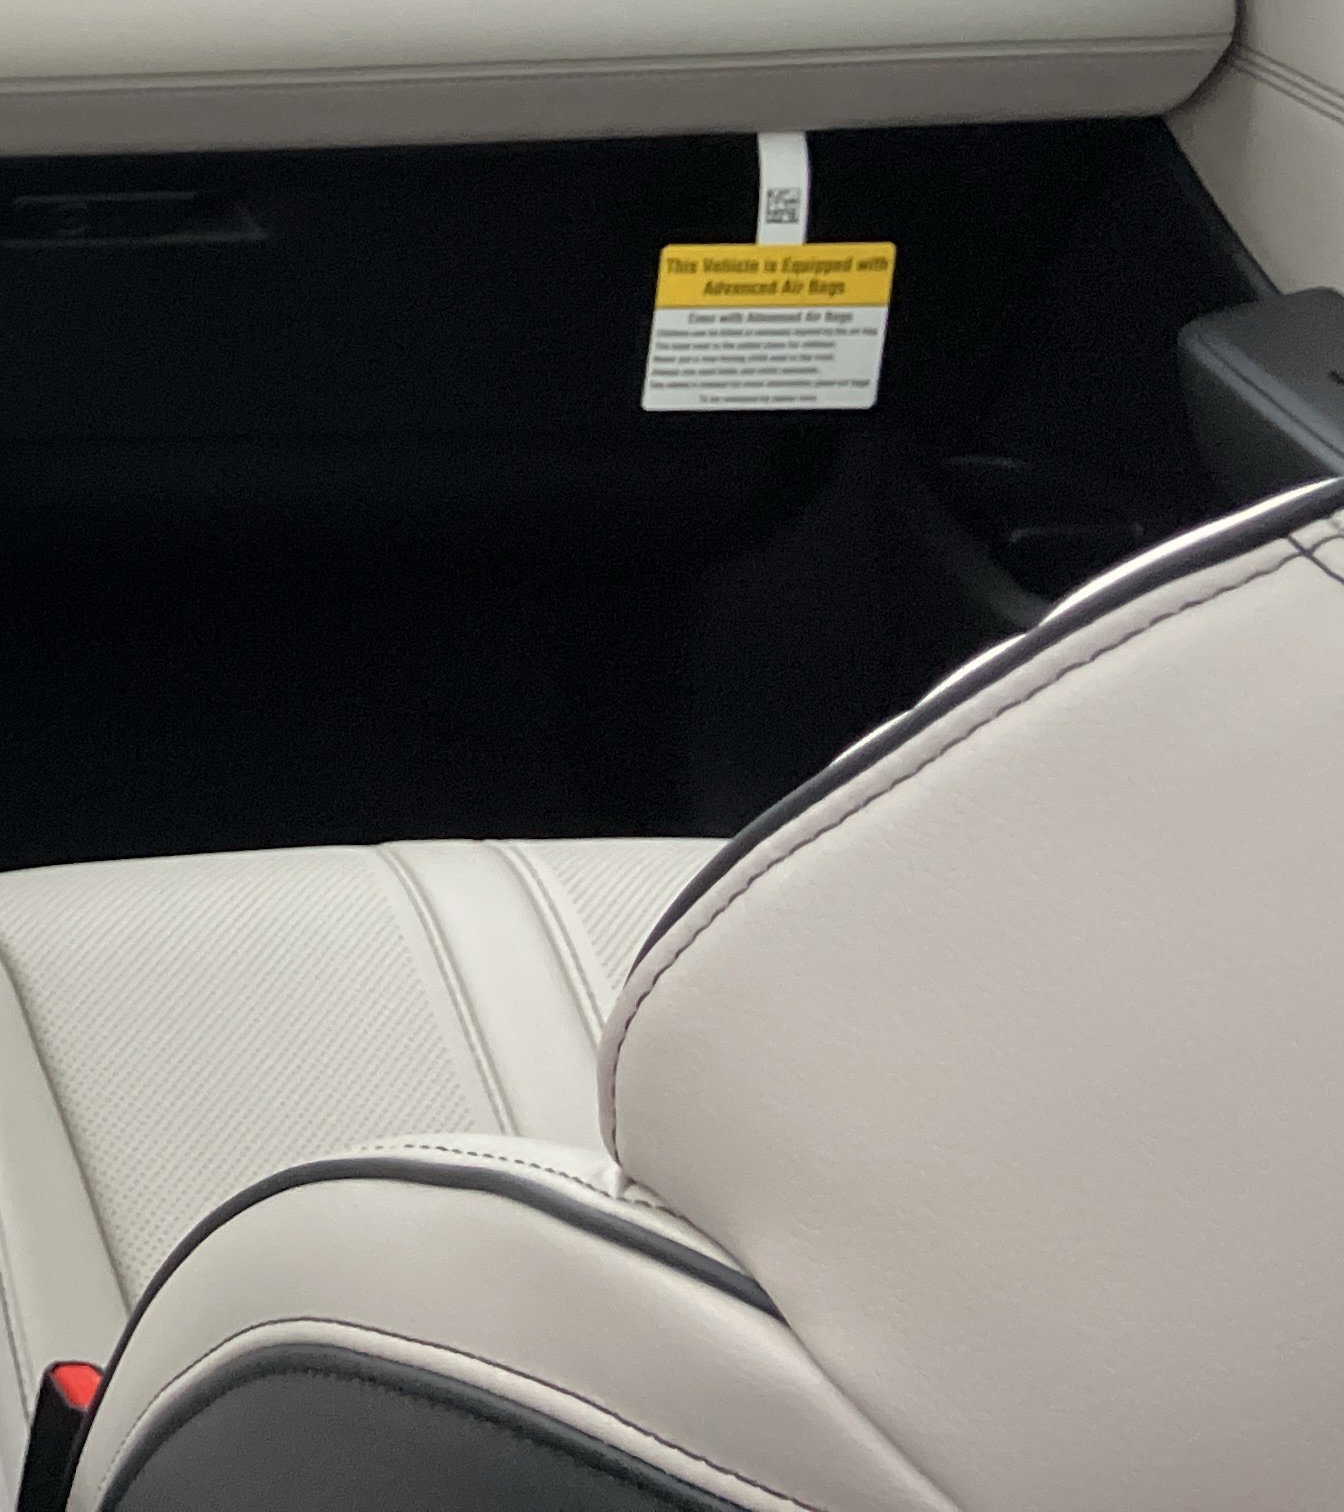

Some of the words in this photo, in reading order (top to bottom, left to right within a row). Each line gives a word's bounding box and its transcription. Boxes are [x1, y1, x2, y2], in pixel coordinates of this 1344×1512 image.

[666, 258, 699, 273] This
[703, 257, 760, 273] Vehicle
[763, 258, 778, 273] is
[781, 256, 854, 275] Equipped
[856, 255, 889, 272] with
[702, 280, 778, 294] Advanced
[781, 279, 804, 294] Air
[808, 279, 846, 297] Bags
